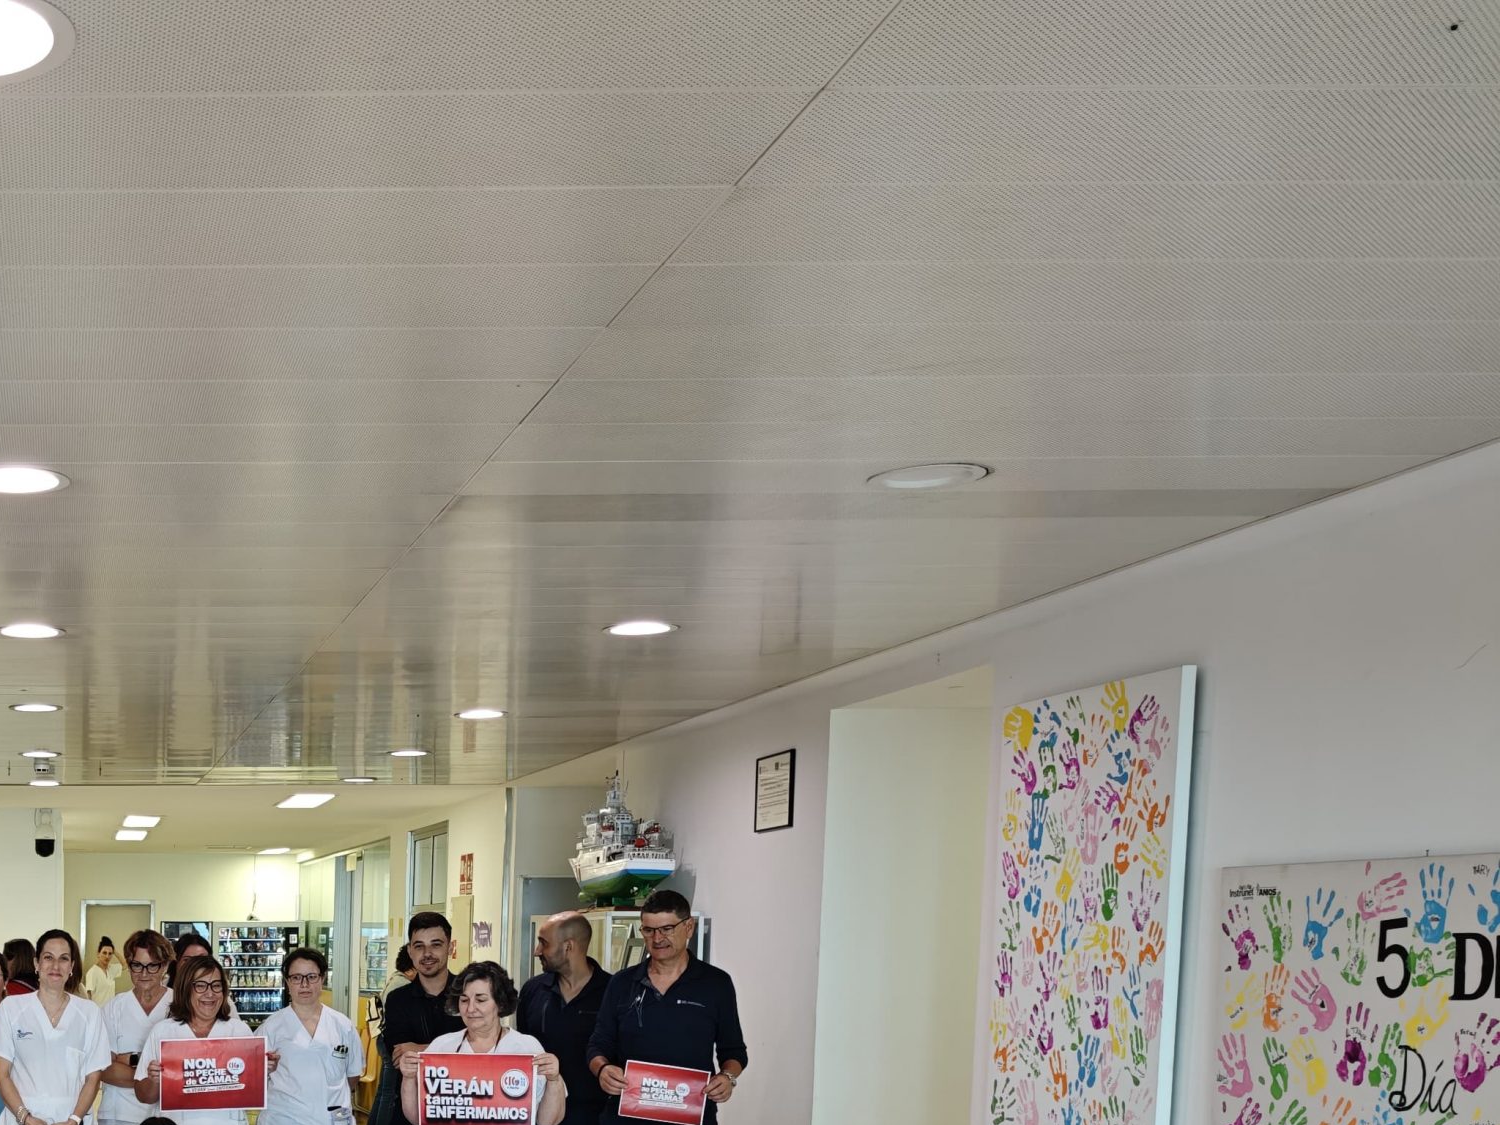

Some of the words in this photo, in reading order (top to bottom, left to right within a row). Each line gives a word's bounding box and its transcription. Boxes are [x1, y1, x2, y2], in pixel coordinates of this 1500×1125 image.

[1376, 917, 1411, 998] 5
[1448, 933, 1500, 1001] D
[184, 1058, 216, 1069] NON
[196, 1069, 226, 1077] PECHE
[425, 1066, 449, 1078] no
[199, 1075, 239, 1084] CAMAS
[1389, 1045, 1458, 1115] Día
[425, 1077, 494, 1096] VERÁN
[425, 1094, 473, 1106] tamén
[426, 1105, 528, 1120] ENFERMAMOS
